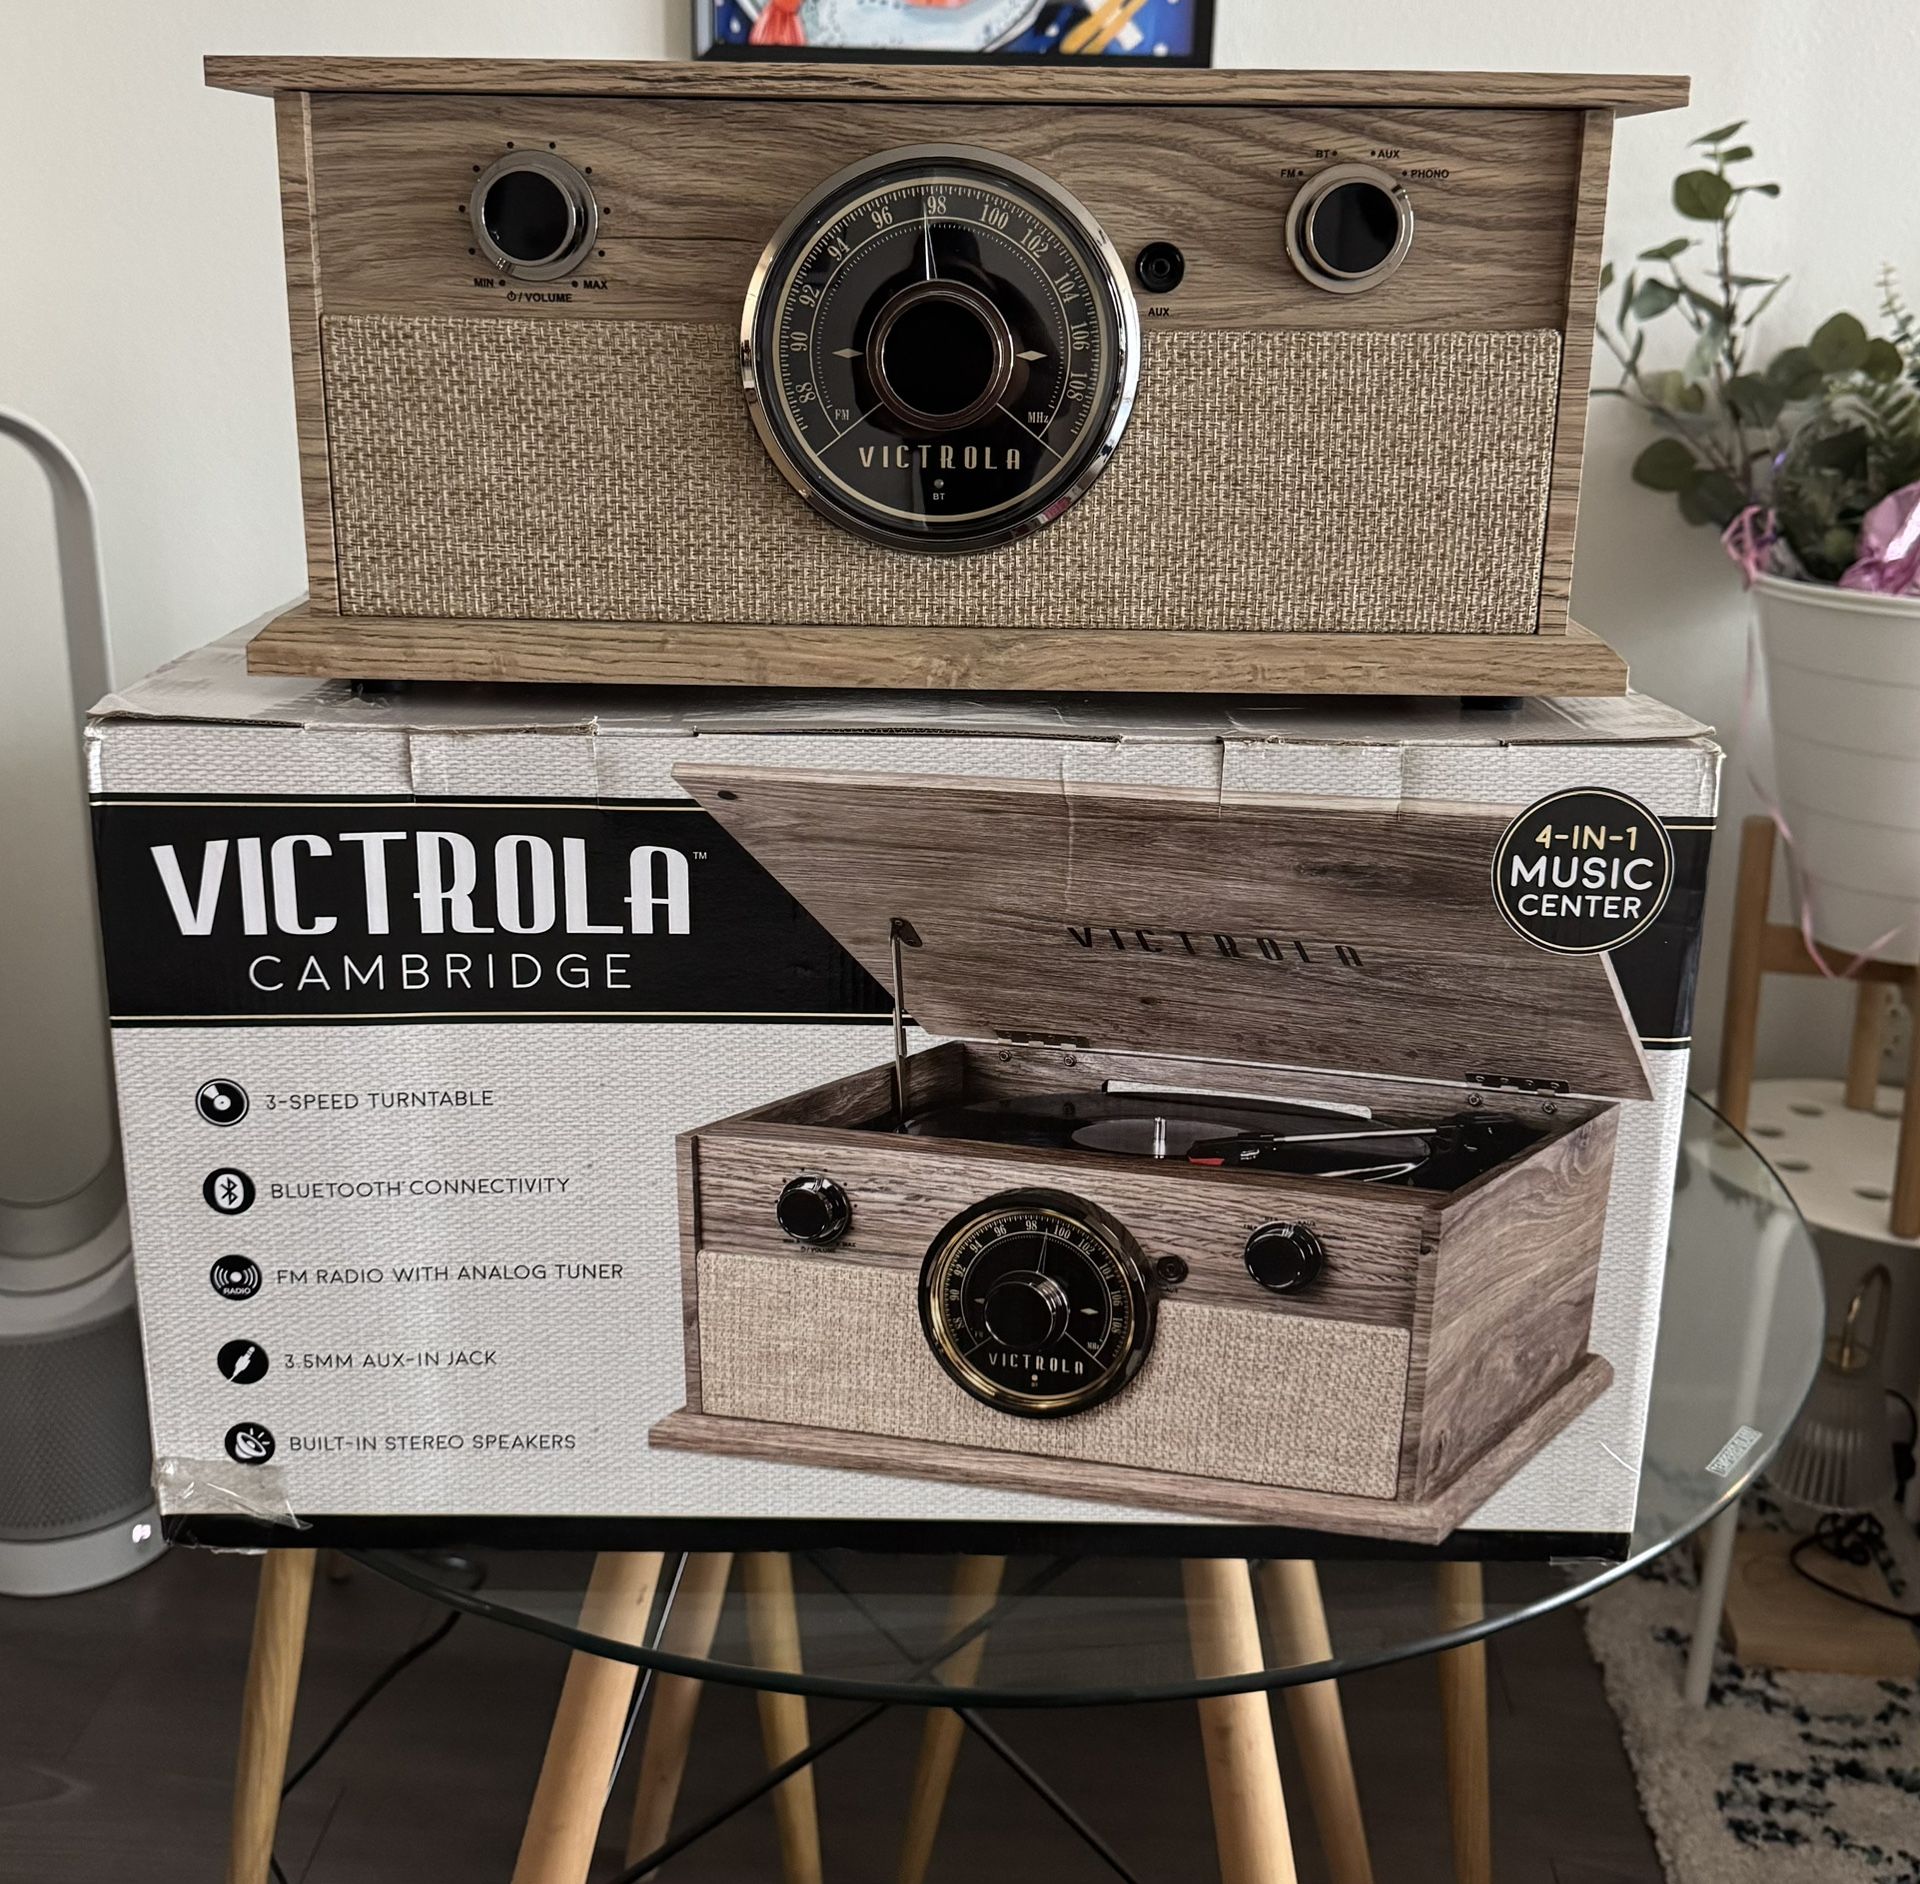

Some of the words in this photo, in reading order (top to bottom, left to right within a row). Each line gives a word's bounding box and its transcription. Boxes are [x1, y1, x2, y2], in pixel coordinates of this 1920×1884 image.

[1315, 150, 1330, 158] BT
[1377, 150, 1400, 159] AUX
[1280, 169, 1296, 179] FM
[1410, 169, 1449, 179] PHONO
[926, 195, 946, 215] 98
[871, 206, 894, 230] 96
[980, 204, 1009, 230] 100
[827, 240, 850, 262] 94
[1019, 228, 1049, 260] 102
[474, 278, 494, 288] MIN
[583, 280, 608, 290] MAX
[1053, 272, 1080, 303] 104
[799, 284, 821, 309] 92
[1148, 308, 1170, 317] AUX
[790, 331, 809, 352] 90
[1070, 321, 1090, 351] 106
[794, 382, 816, 403] 88
[1066, 372, 1087, 402] 108
[834, 409, 850, 422] FM
[1027, 411, 1049, 424] MHz
[858, 444, 1021, 470] VICTROLA
[932, 492, 945, 500] BT
[1535, 824, 1638, 851] 4-IN-1
[150, 830, 690, 936] VICTROLA
[1510, 856, 1654, 891] MUSIC
[1518, 894, 1642, 920] CENTER
[1066, 926, 1364, 968] VICTROLA
[248, 952, 633, 992] CAMBRIDGE
[266, 1093, 358, 1110] 3-SPEED
[368, 1090, 494, 1108] TURNTABLE
[271, 1181, 400, 1200] BLUETOOTH
[409, 1177, 570, 1196] CONNECTIVITY
[954, 1264, 967, 1278] 92
[994, 1224, 1008, 1238] 96
[1026, 1220, 1038, 1231] 98
[1053, 1224, 1072, 1240] 100
[1078, 1239, 1096, 1256] 102
[277, 1269, 308, 1285] FM
[316, 1268, 384, 1284] RADIO
[392, 1266, 449, 1282] WITH
[457, 1264, 546, 1282] ANALOG
[555, 1263, 624, 1280] TUNER
[223, 1287, 251, 1295] RADIO
[284, 1353, 354, 1370] 3.5MM
[362, 1351, 440, 1368] AUX-IN
[447, 1349, 498, 1367] JACK
[988, 1352, 1084, 1375] VICTROLA
[289, 1435, 377, 1452] BUILT-IN
[384, 1434, 464, 1451] STEREO
[472, 1434, 577, 1451] SPEAKERS
